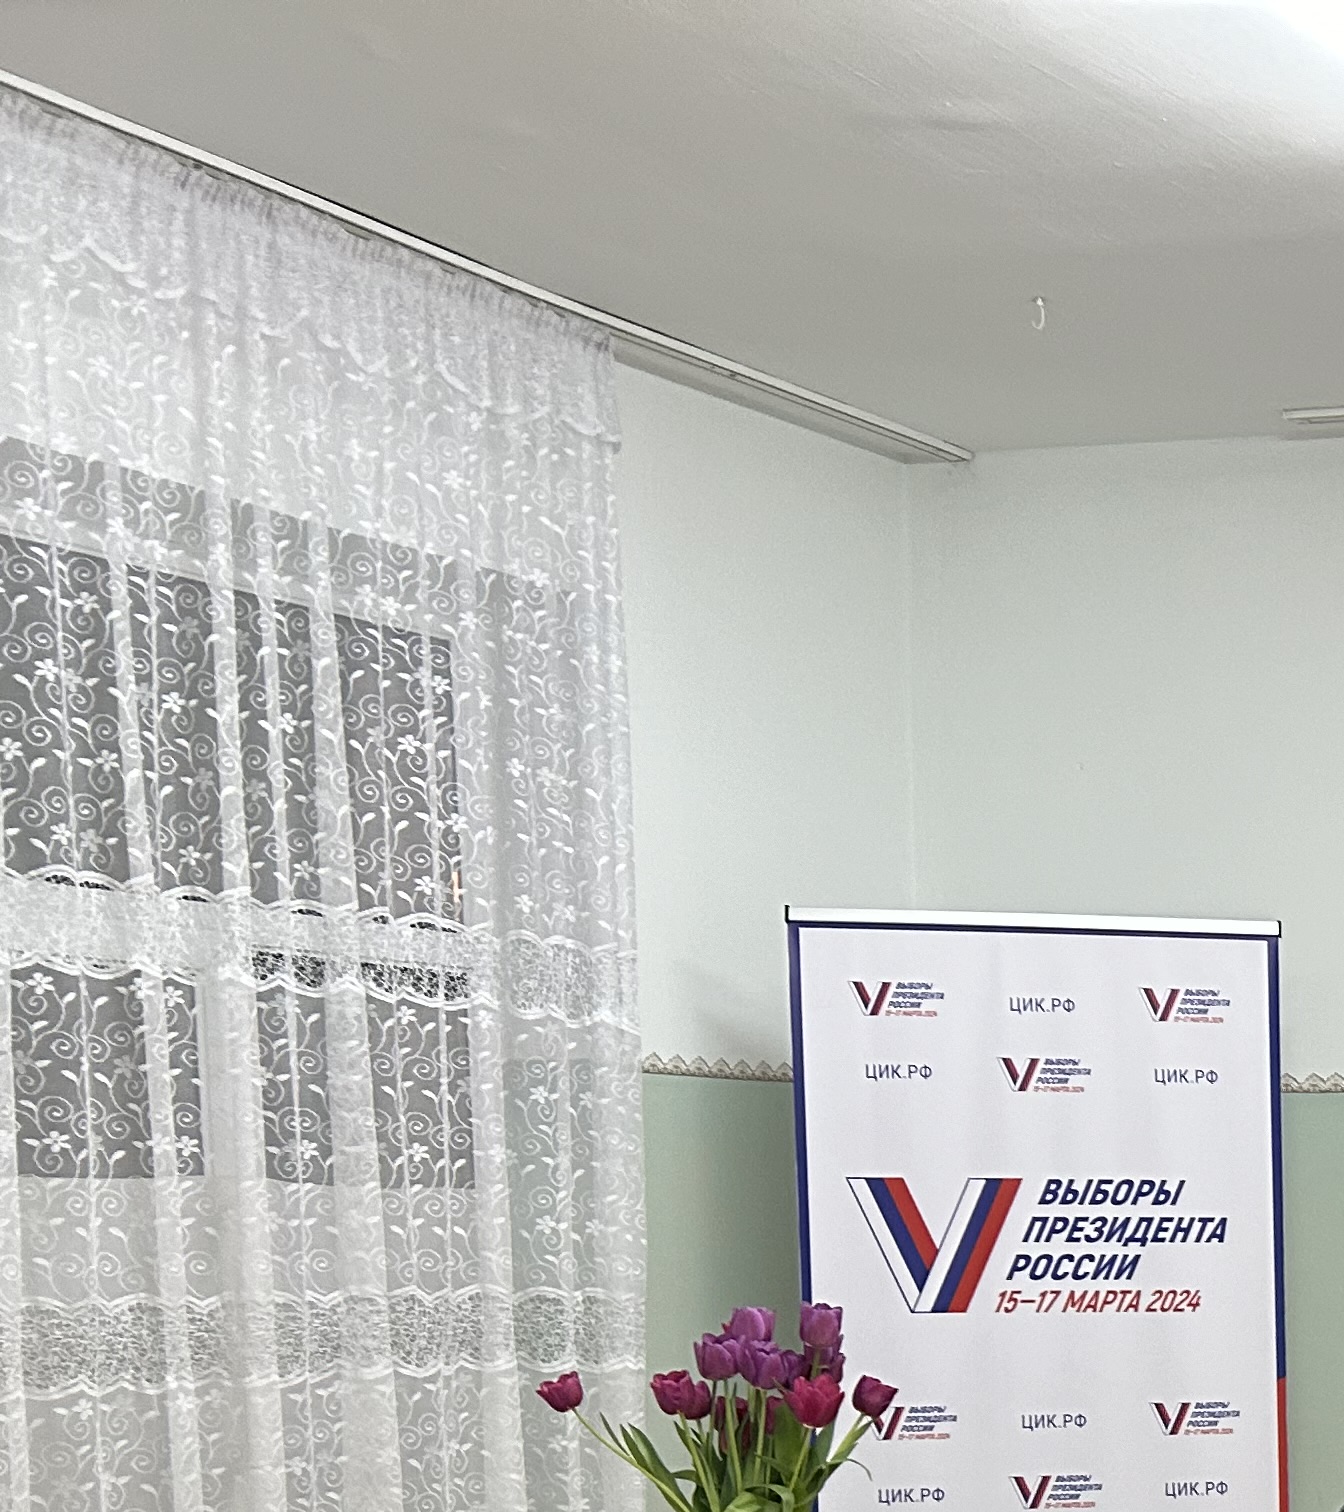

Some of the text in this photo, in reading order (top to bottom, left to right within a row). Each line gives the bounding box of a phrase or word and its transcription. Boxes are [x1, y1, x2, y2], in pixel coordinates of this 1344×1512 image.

[1009, 996, 1075, 1016] ЦИК.РФ
[864, 1062, 933, 1081] ЦИК.РФ
[1154, 1068, 1219, 1086] ЦИК.РФ
[1038, 1178, 1186, 1206] ВЫБОРЫ
[1022, 1216, 1228, 1247] ПРЕЗИДЕНТА
[1006, 1253, 1141, 1282] РОССИИ
[1062, 1290, 1141, 1314] МАРТА
[1144, 1290, 1201, 1314] 2024
[1021, 1413, 1088, 1431] ЦИК.РФ
[877, 1487, 946, 1506] ЦИК.РФ
[1164, 1480, 1228, 1498] ЦИК.РФ
